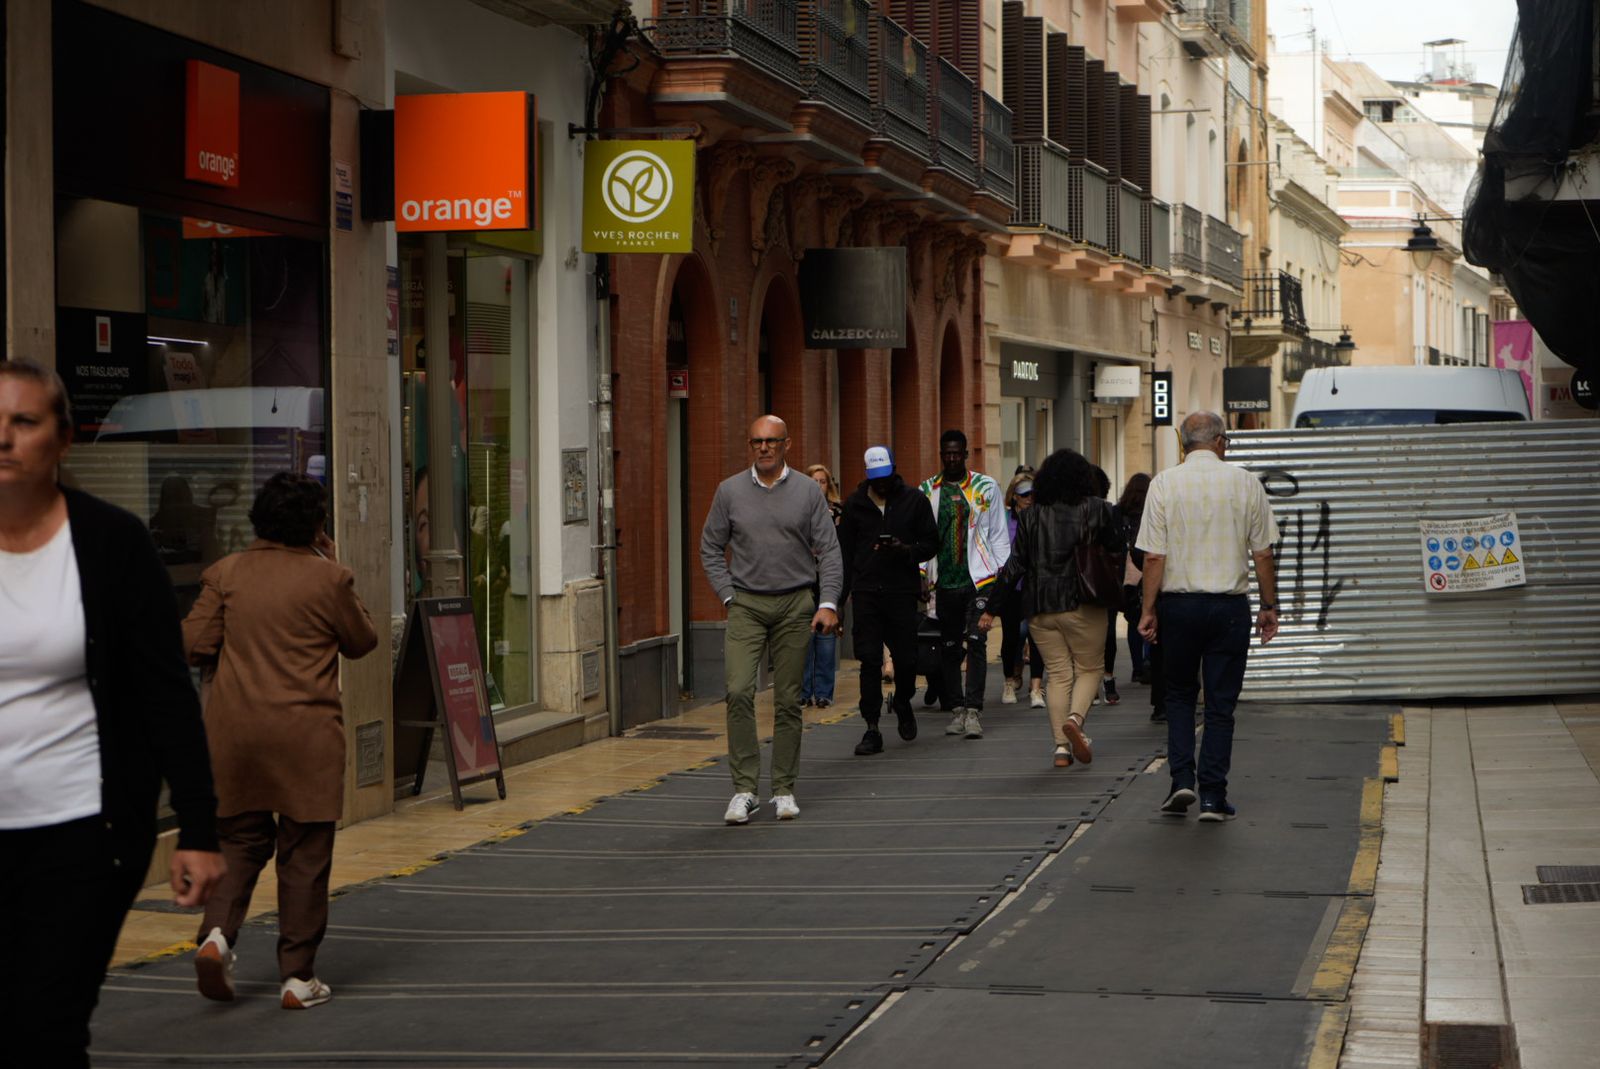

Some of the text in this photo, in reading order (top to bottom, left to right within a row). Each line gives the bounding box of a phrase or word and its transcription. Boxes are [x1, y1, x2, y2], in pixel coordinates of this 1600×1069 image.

[199, 150, 236, 181] orange
[401, 198, 512, 226] orange
[593, 231, 680, 240] YVES ROCHER
[1227, 400, 1269, 409] TEZENIS
